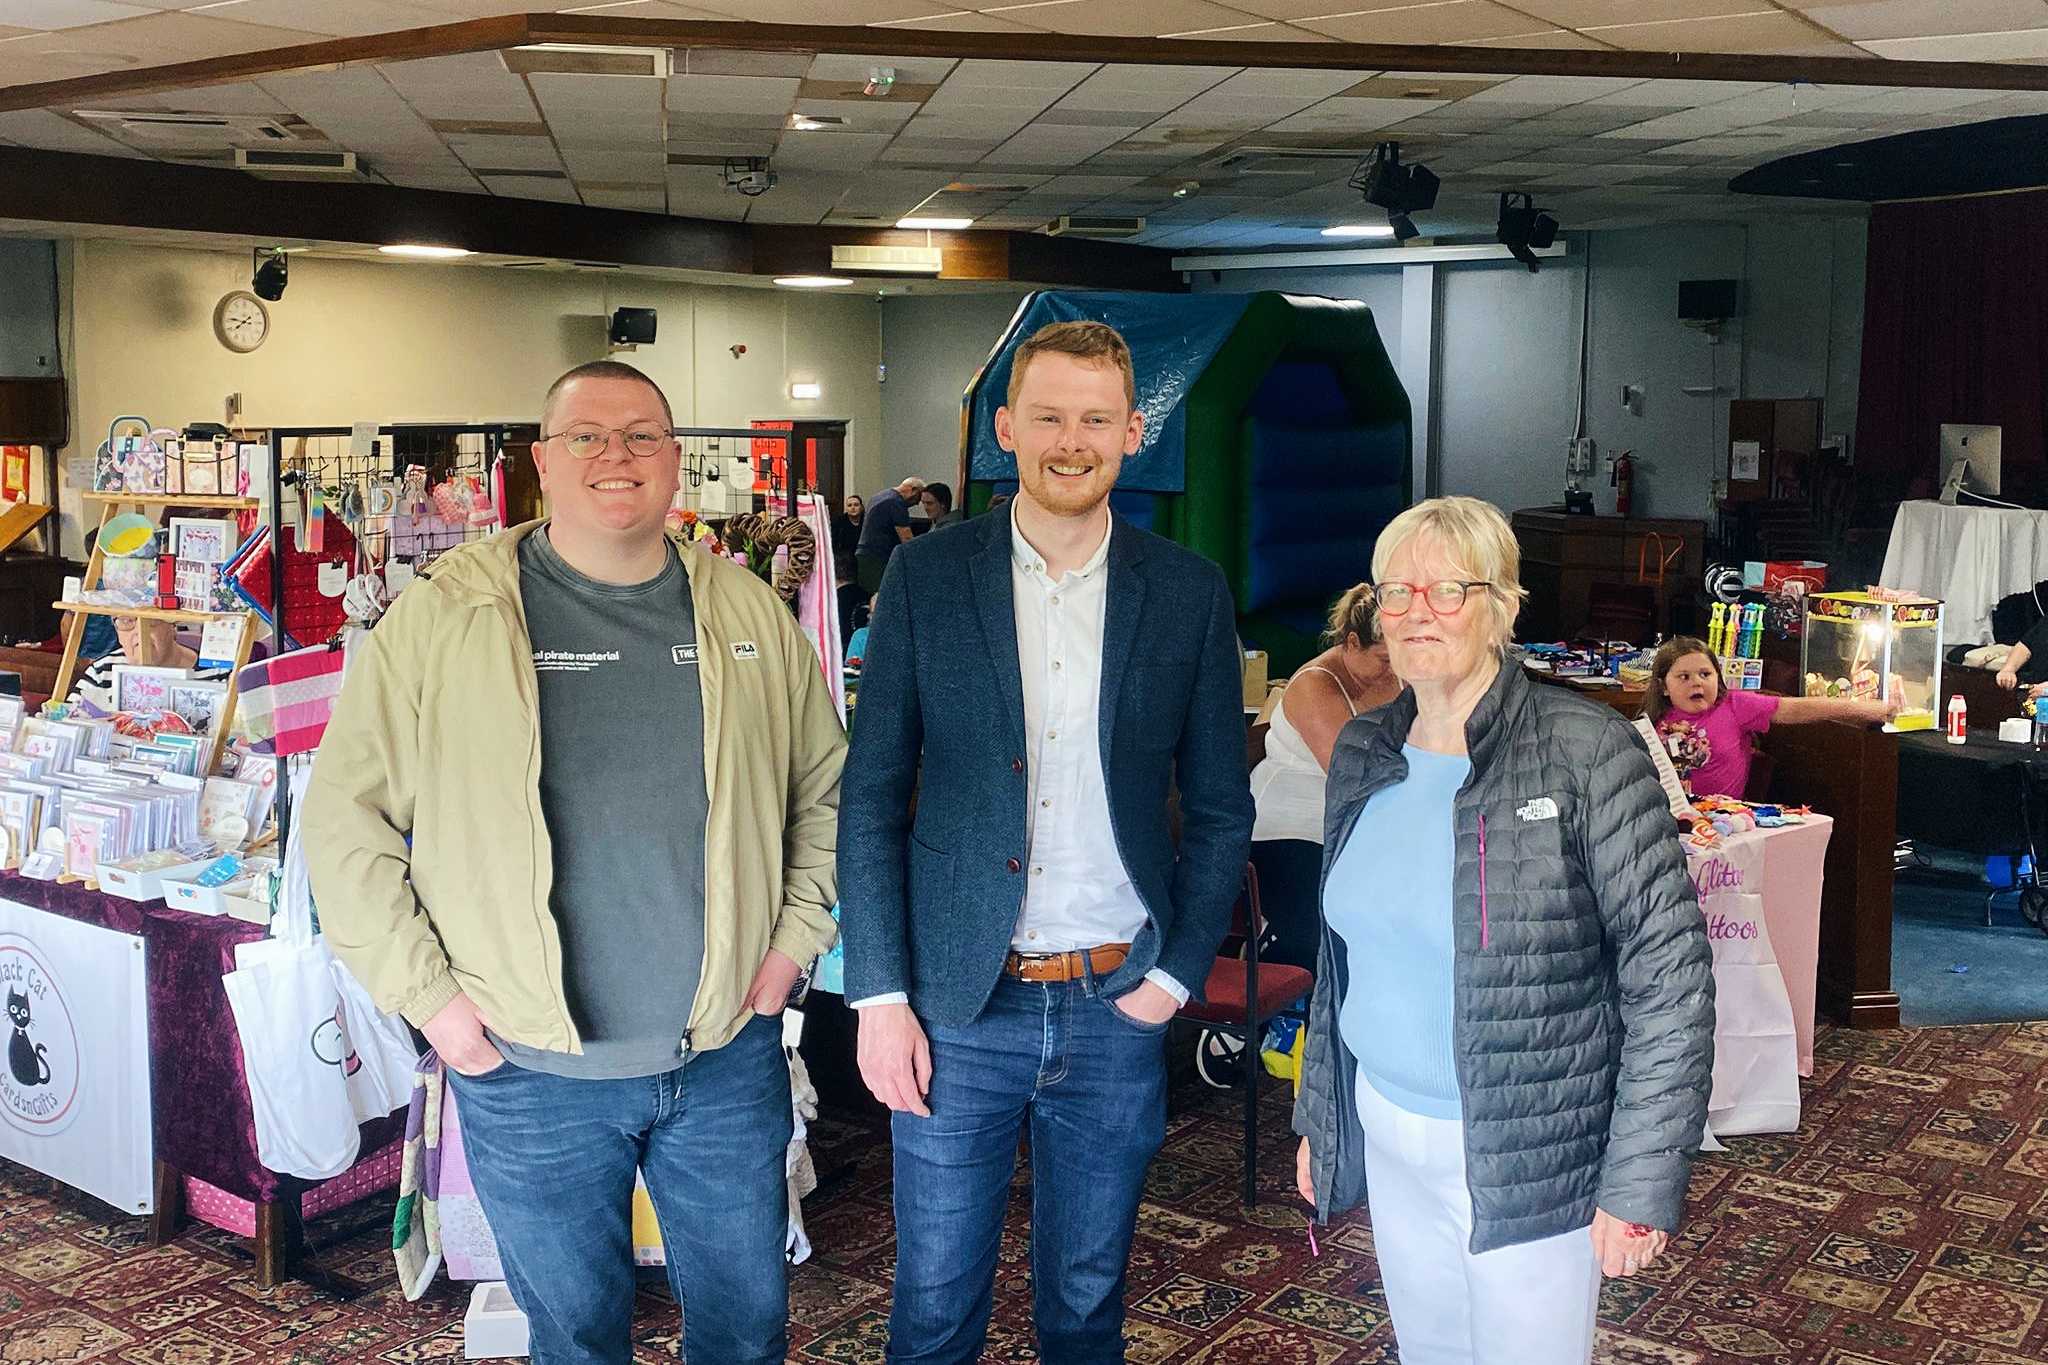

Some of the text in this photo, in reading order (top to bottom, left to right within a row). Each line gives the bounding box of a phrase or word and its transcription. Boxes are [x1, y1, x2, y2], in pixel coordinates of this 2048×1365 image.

[678, 648, 695, 659] THE
[734, 644, 755, 653] FILA
[544, 650, 575, 661] pirate
[576, 650, 619, 661] material
[0, 956, 47, 1000] lack Cat
